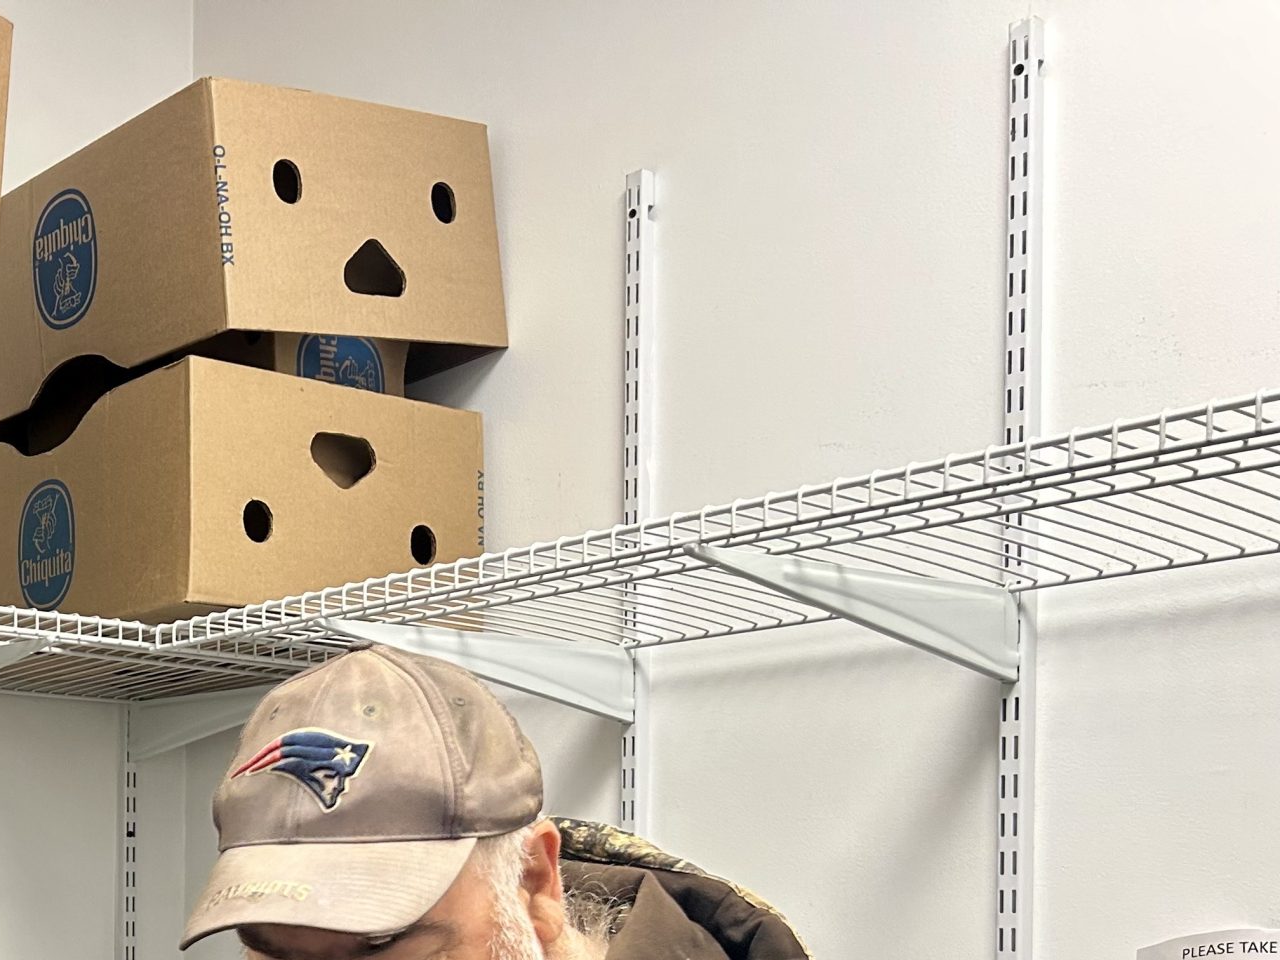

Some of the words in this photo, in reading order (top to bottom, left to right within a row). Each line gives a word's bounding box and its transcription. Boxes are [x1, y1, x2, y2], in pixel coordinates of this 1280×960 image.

[35, 213, 93, 262] Chiquita
[221, 242, 235, 266] BX
[315, 336, 338, 382] Chiq
[21, 548, 72, 587] Chiquita
[1182, 942, 1235, 960] PLEASE
[1239, 941, 1278, 954] TAKE
